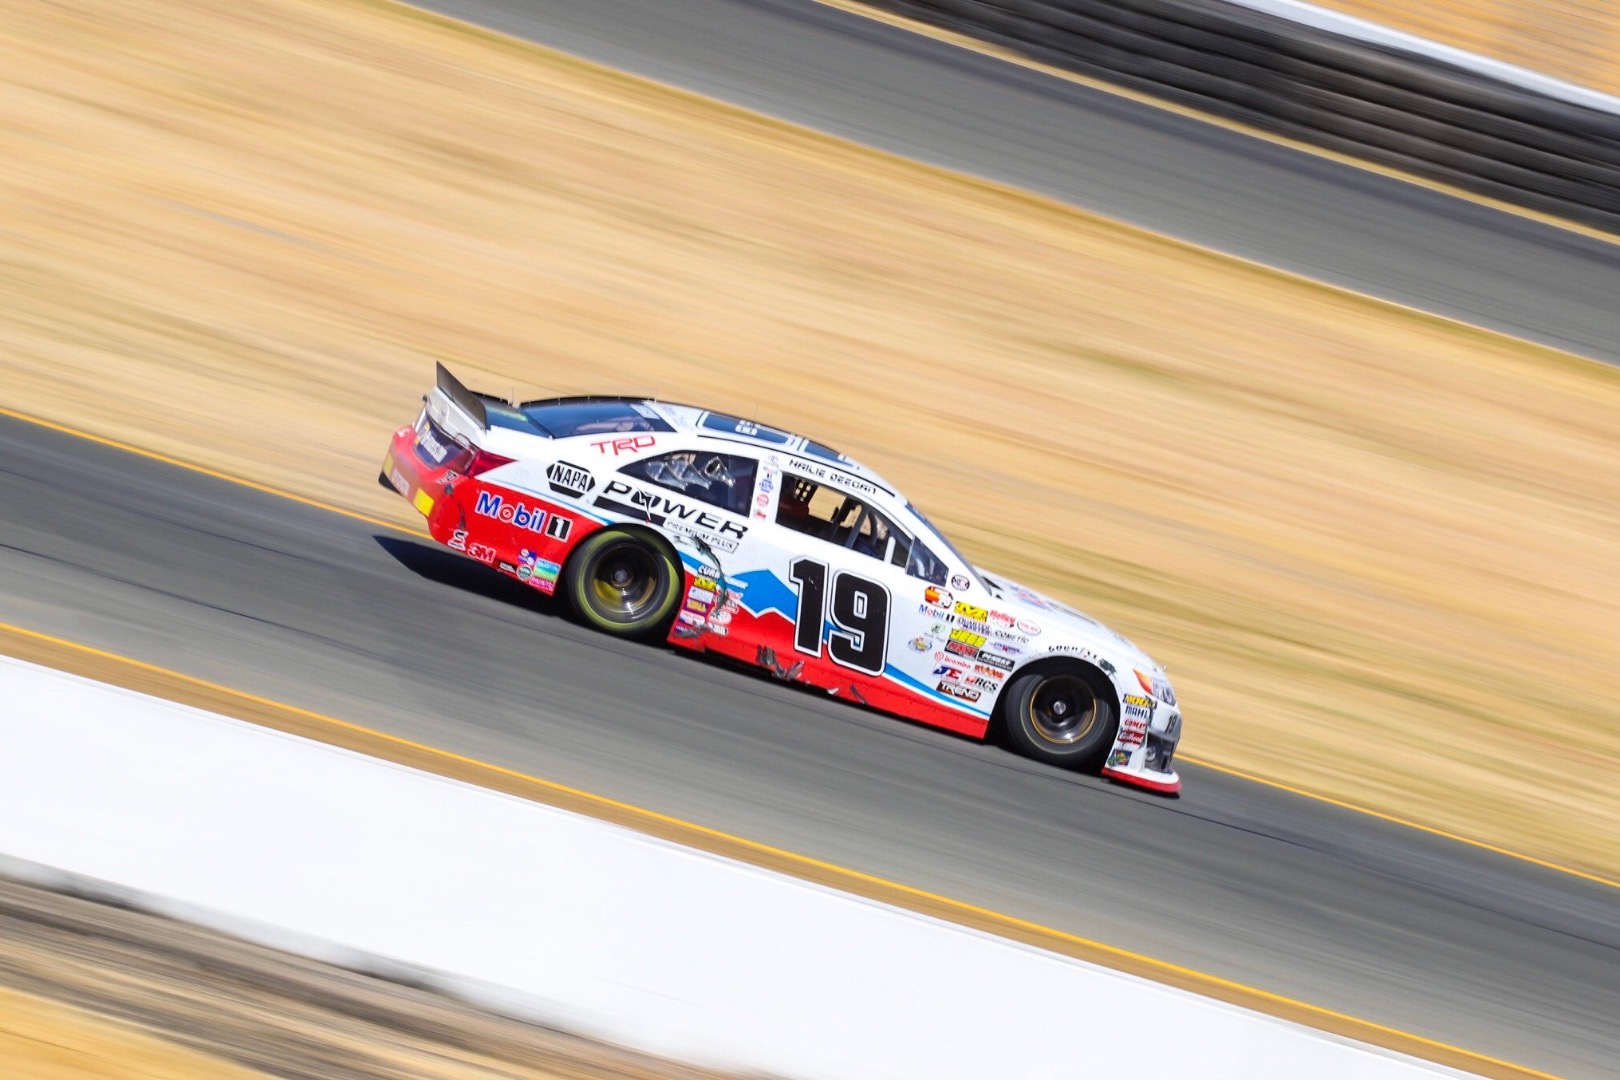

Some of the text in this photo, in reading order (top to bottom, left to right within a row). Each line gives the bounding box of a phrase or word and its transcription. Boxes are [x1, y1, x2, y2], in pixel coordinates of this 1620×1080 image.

[590, 434, 656, 456] TRD
[551, 464, 589, 492] NAPA
[475, 490, 547, 533] Mobil
[603, 480, 749, 540] POWER
[467, 542, 497, 563] 3M
[789, 555, 891, 677] 19
[919, 604, 945, 619] Mobil
[989, 609, 1016, 624] Holley
